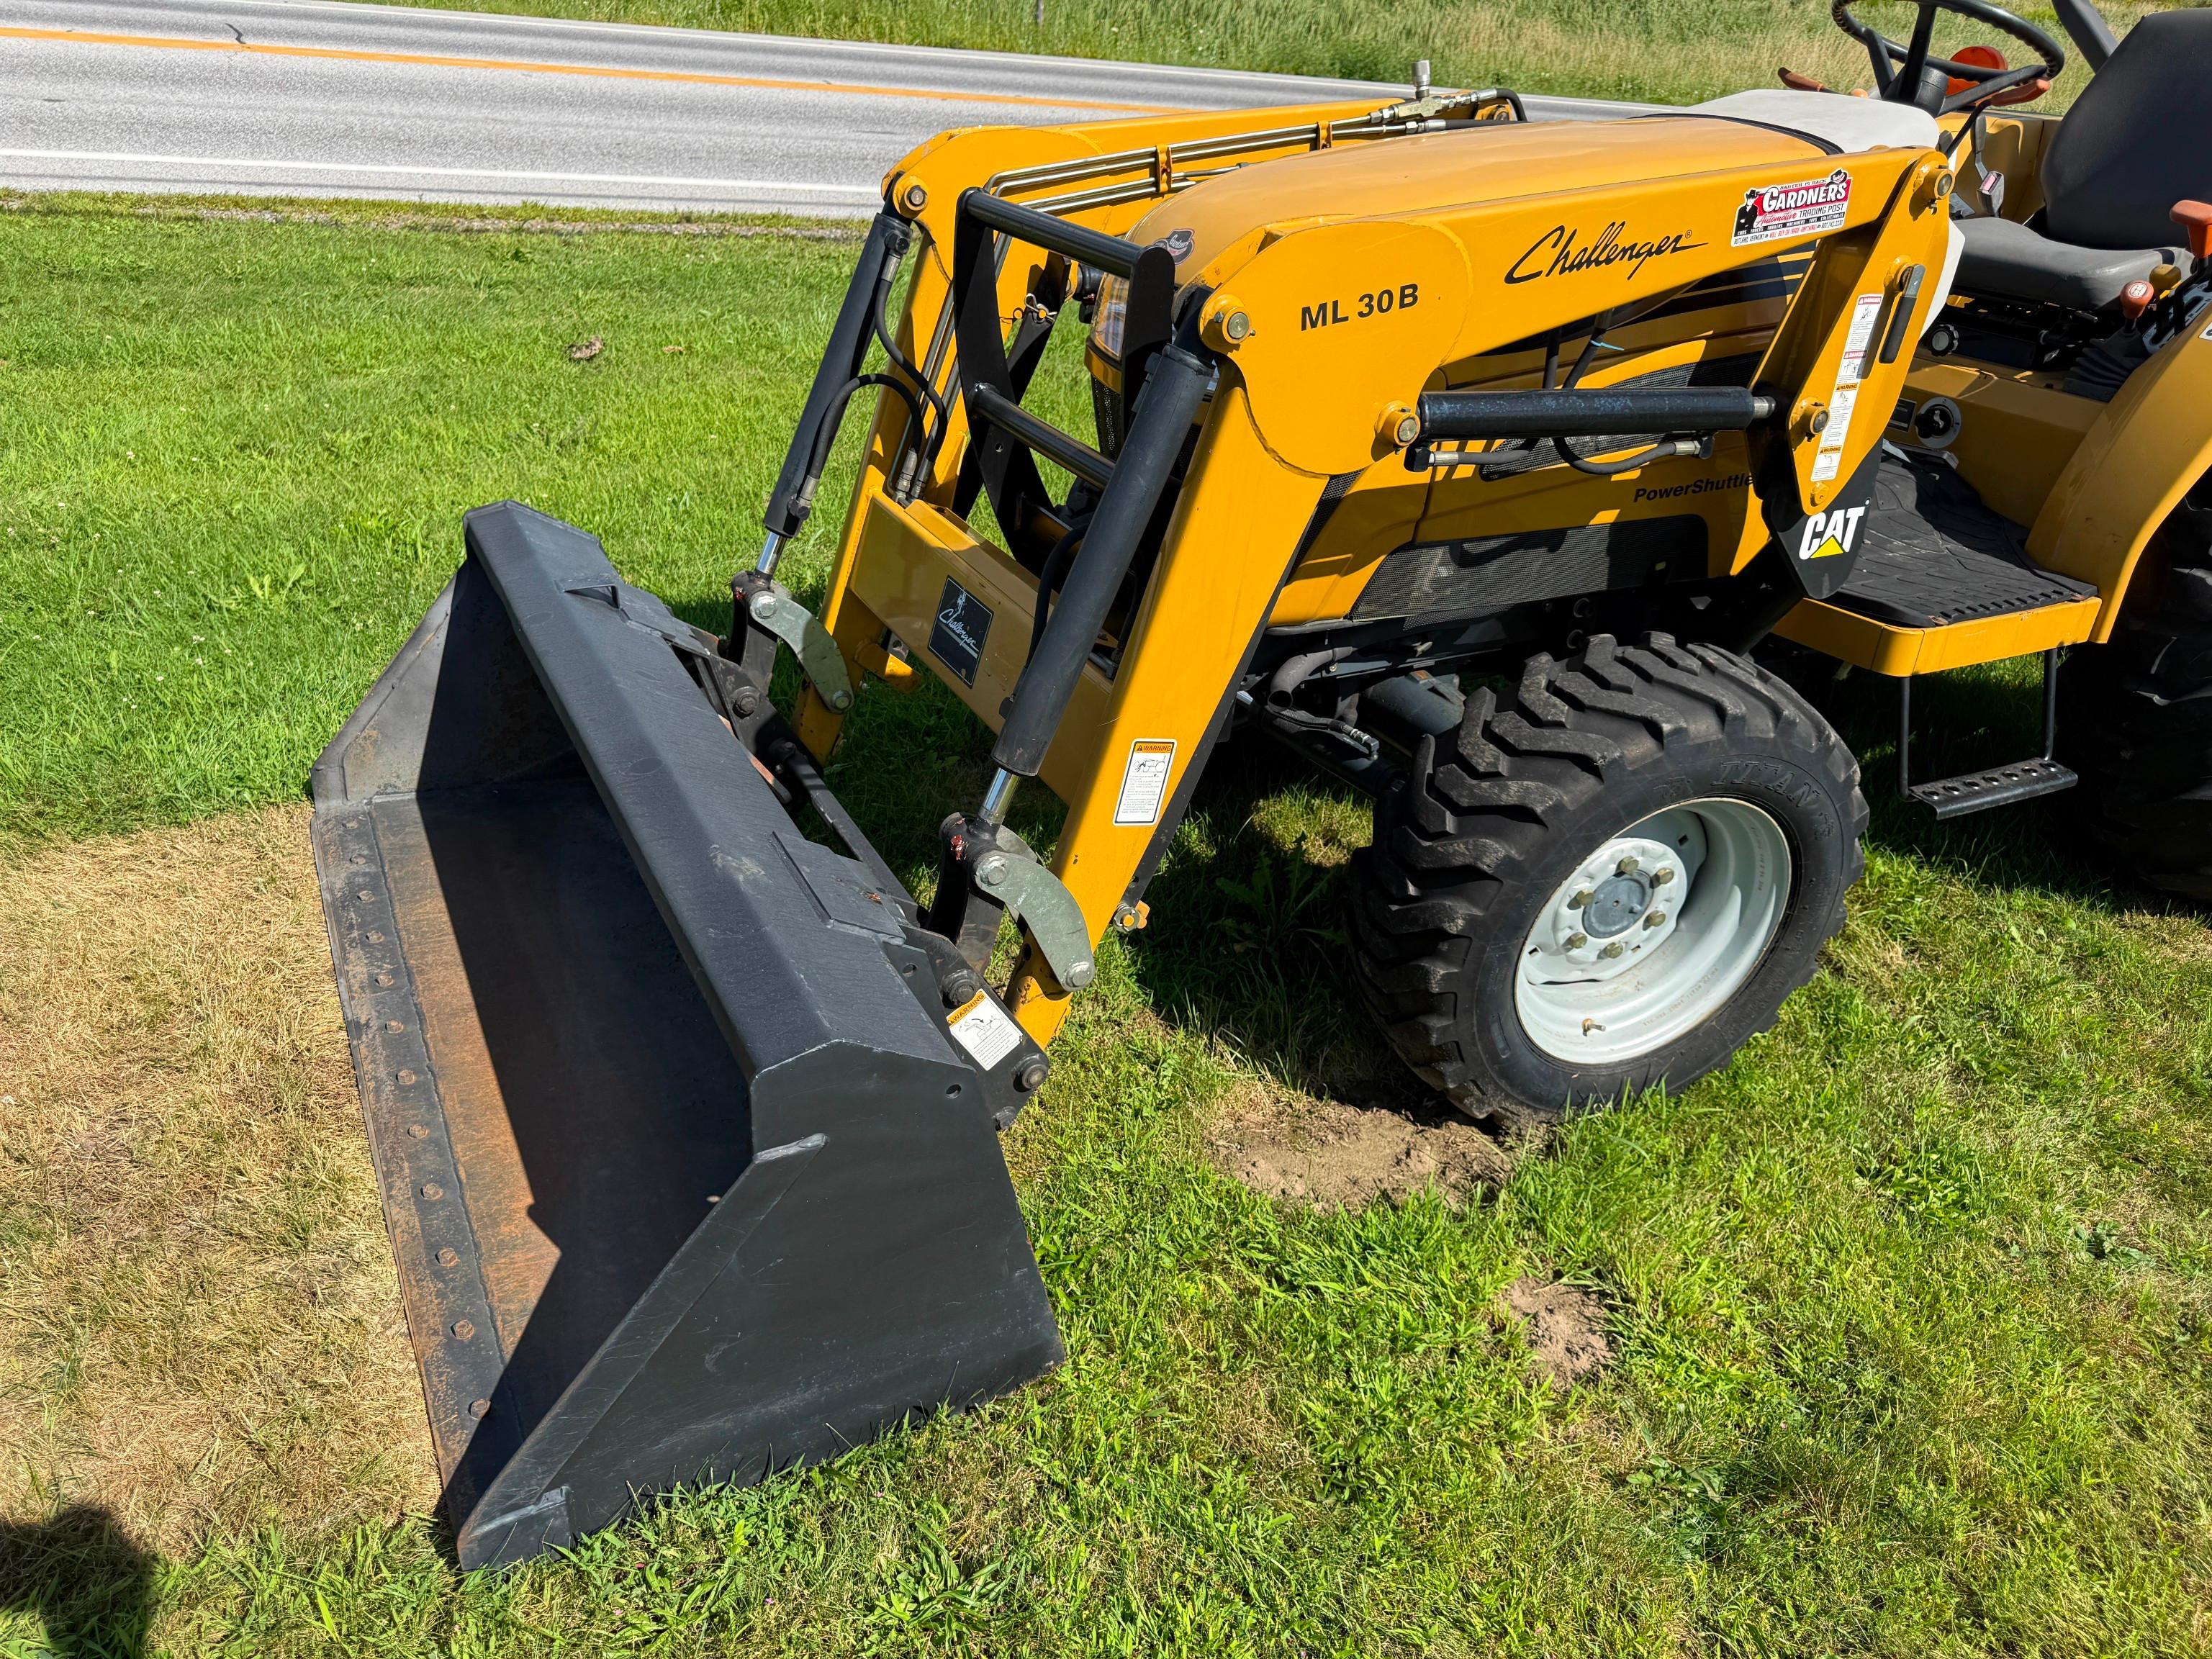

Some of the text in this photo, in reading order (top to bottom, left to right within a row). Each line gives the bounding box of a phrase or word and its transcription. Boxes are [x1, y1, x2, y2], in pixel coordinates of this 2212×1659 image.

[1763, 183, 1847, 212] GARDNERS
[1756, 203, 1845, 226] Automotive TRADING POST
[1301, 305, 1349, 332] ML
[1633, 472, 1753, 502] PowerShuttle
[1800, 506, 1864, 560] CAT
[939, 608, 980, 652] Challenger
[1710, 760, 1821, 808] TITAN
[952, 994, 985, 1023] WARNING
